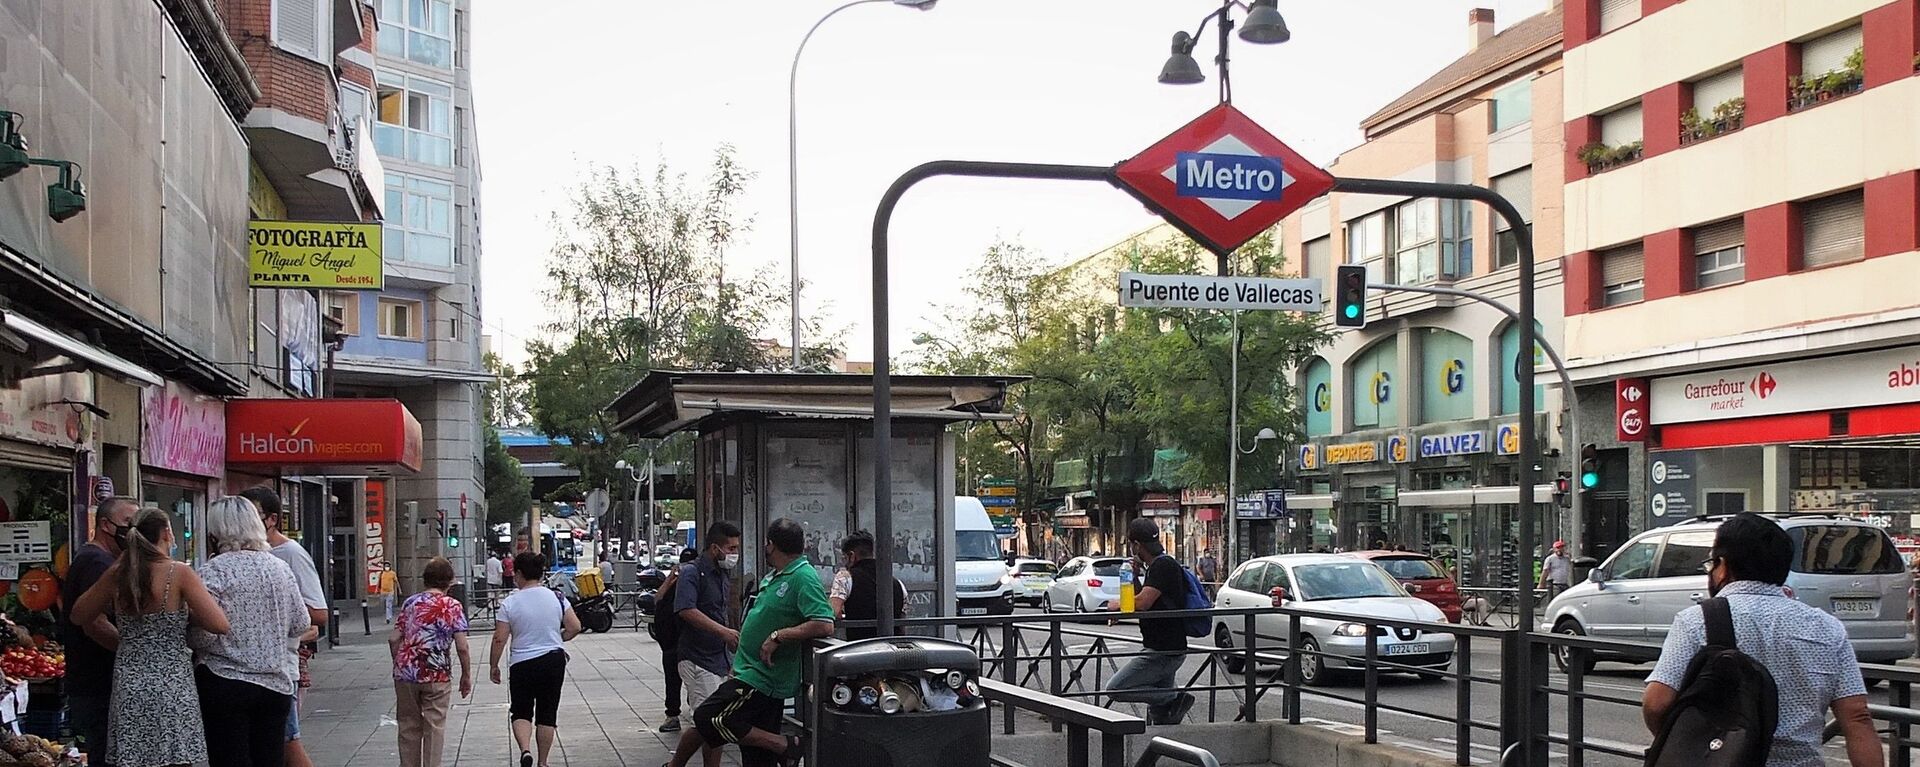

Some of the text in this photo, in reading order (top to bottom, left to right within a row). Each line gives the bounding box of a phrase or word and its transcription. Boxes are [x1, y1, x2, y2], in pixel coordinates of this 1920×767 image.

[1187, 158, 1275, 192] Metro
[249, 226, 368, 248] FOTOGRAFÍA
[256, 249, 306, 271] Miguel
[254, 273, 311, 282] PLANTA
[336, 274, 374, 285] Desde 1954
[1129, 279, 1314, 305] Puente de Vallecas
[1888, 361, 1920, 388] abi
[1685, 379, 1745, 399] Carrefour
[1711, 397, 1744, 411] market
[1625, 417, 1641, 427] 24/7
[1327, 445, 1374, 463] DEPORTES
[1421, 433, 1480, 456] GALVEZ
[366, 522, 384, 586] BASIC
[907, 591, 932, 605] AN
[1836, 602, 1856, 611] 0492
[1391, 645, 1410, 654] 0224
